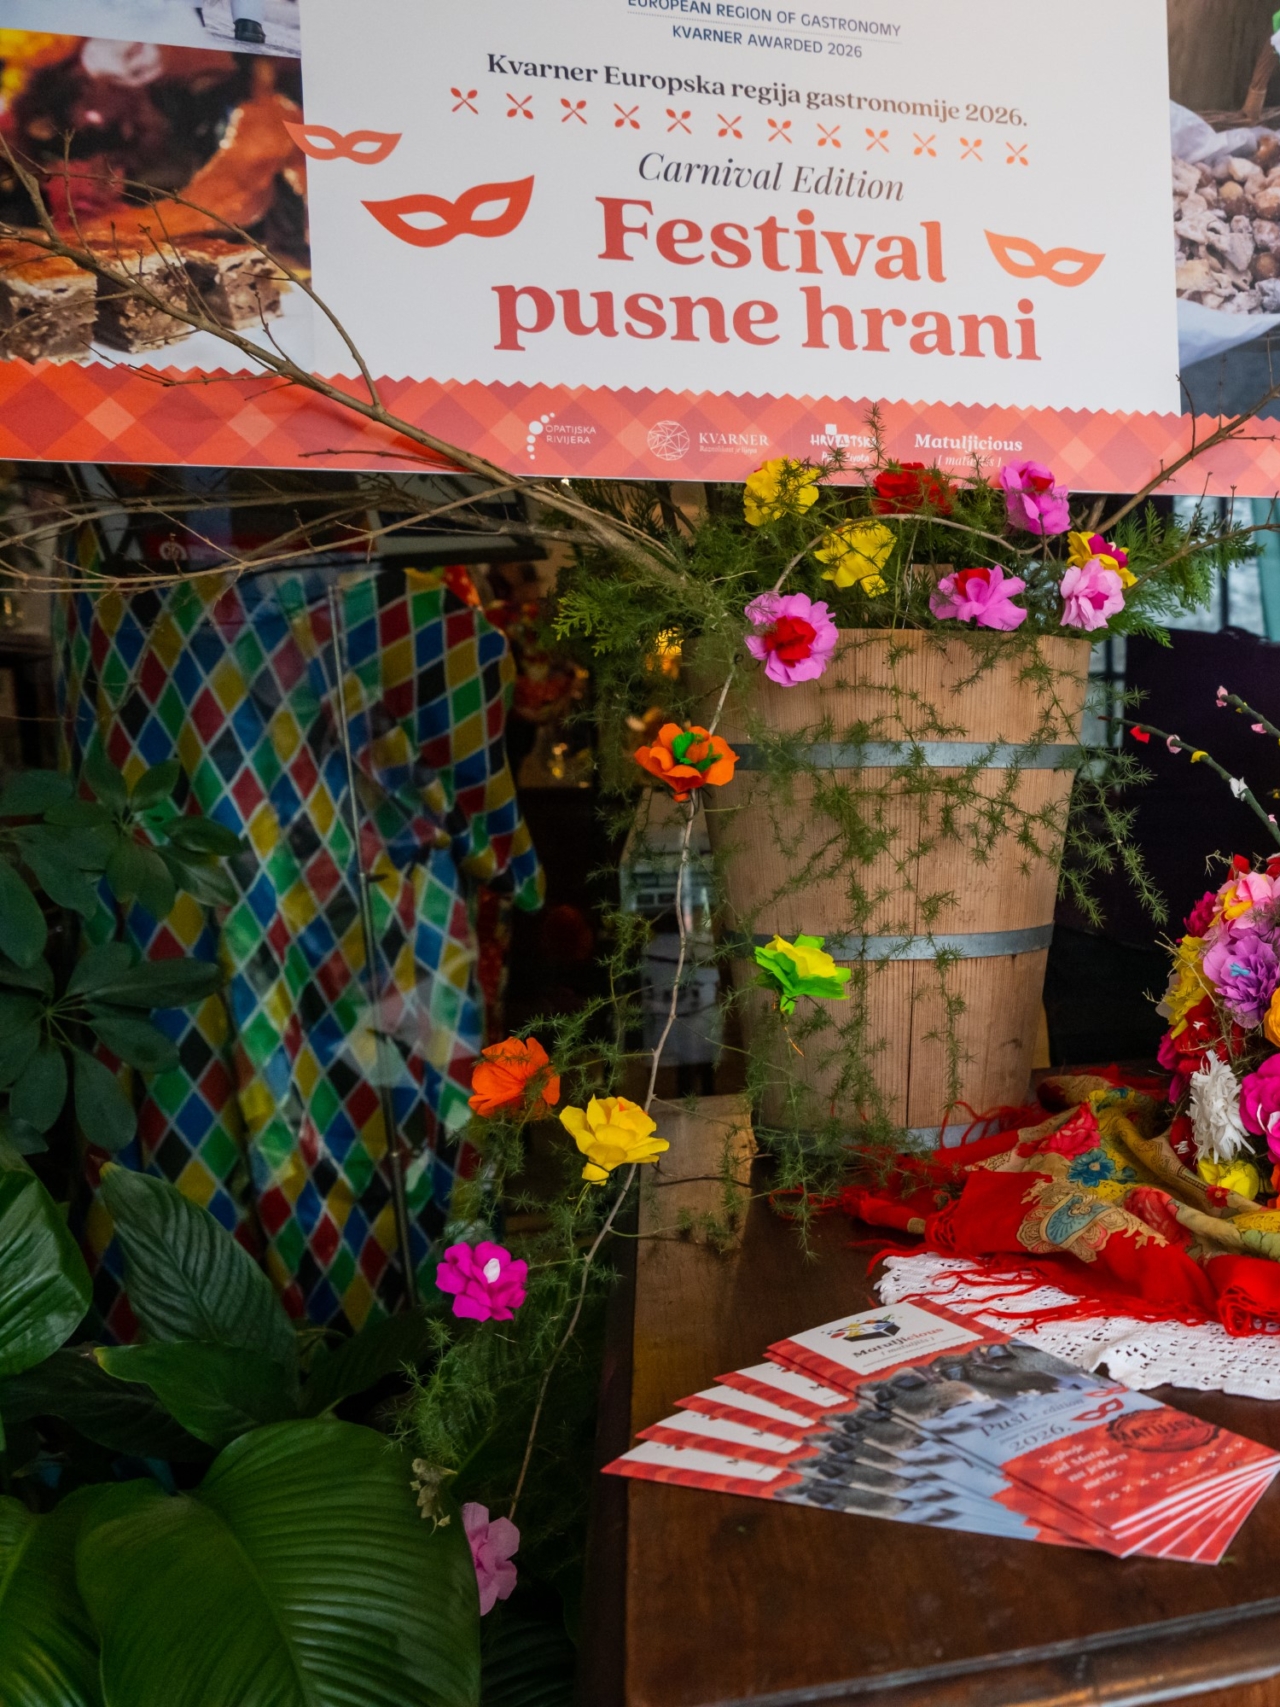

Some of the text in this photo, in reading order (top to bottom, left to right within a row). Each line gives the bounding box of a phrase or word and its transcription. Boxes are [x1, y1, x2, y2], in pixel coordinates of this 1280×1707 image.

[627, 0, 901, 37] EUROPEAN REGION OF GASTRONOMY
[672, 25, 863, 59] KVARNER AWARDED 2026
[487, 53, 1028, 127] Kvarner Europska regija gastronomije 2026.
[638, 151, 905, 202] Carnival Edition
[595, 196, 947, 284] Festival
[491, 283, 1042, 362] pusne hrani
[545, 424, 597, 435] OPATIJSKA
[546, 434, 592, 445] RIVIJERA
[698, 432, 769, 446] KVARNER
[914, 433, 1023, 454] Matuljicious
[853, 1327, 944, 1358] Matuljicious
[981, 1411, 1031, 1437] Pust
[1010, 1423, 1071, 1453] 2026.
